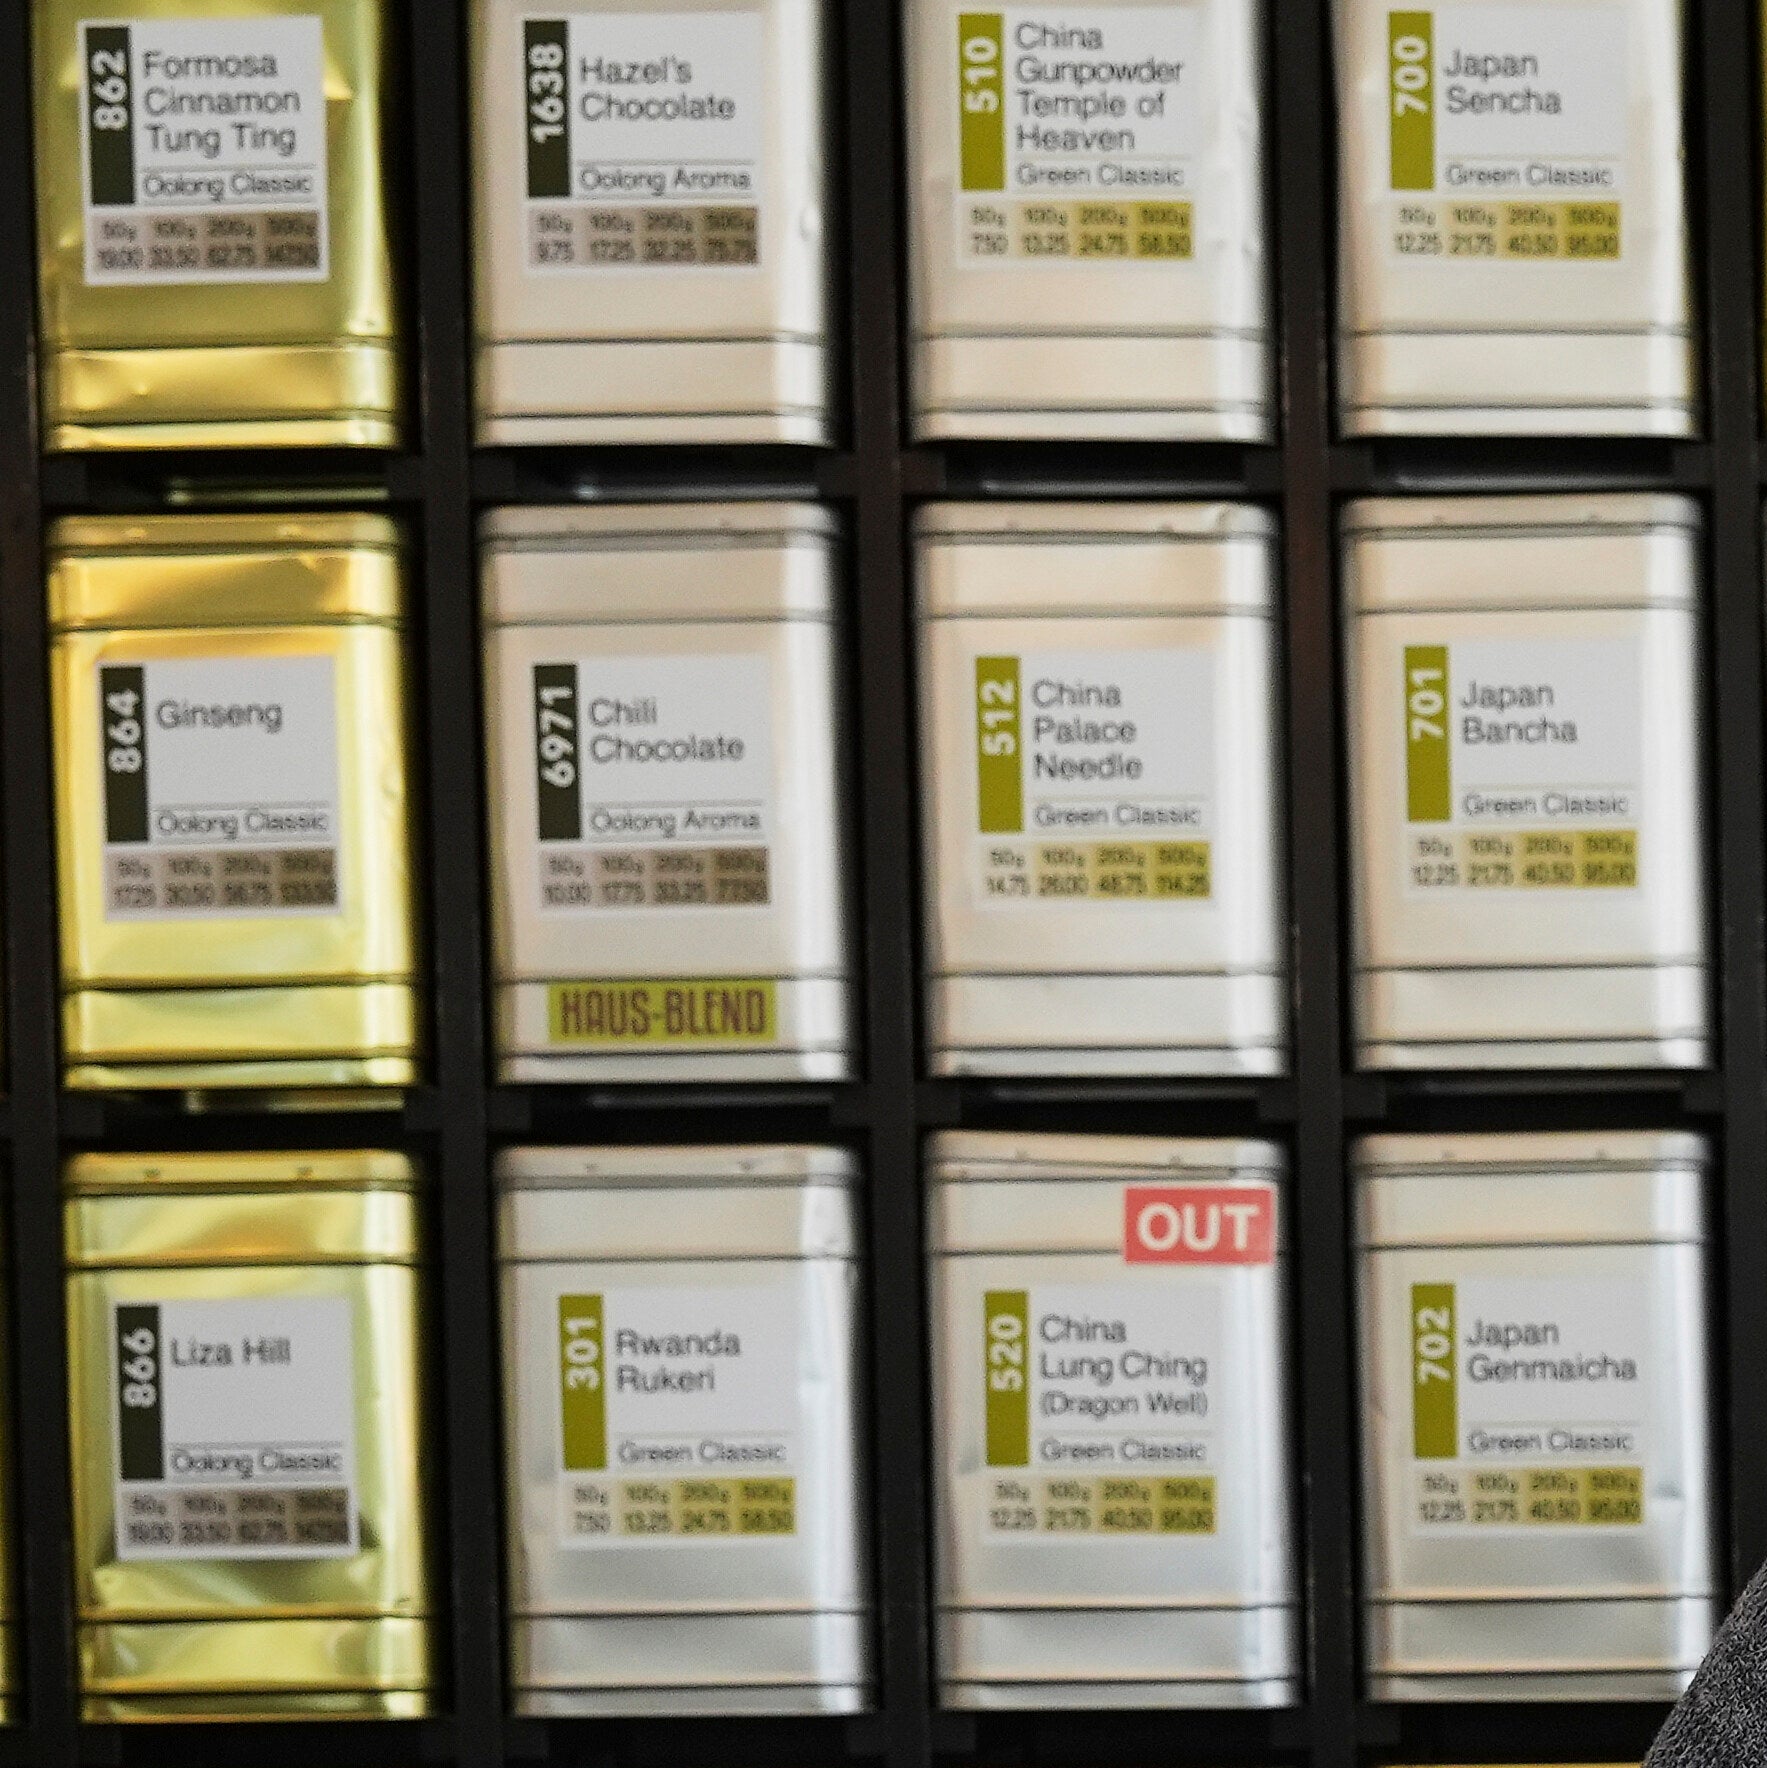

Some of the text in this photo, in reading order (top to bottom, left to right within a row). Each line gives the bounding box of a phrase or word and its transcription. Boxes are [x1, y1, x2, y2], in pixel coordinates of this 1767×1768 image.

[1014, 21, 1104, 51] China
[142, 50, 278, 80] Formosa
[579, 55, 692, 85] Hazel's
[1015, 56, 1183, 88] Gunpowder
[1394, 35, 1428, 117] 700
[1443, 49, 1538, 82] Japan
[143, 86, 301, 117] Cinnamon
[531, 43, 564, 143] 1638
[579, 92, 735, 121] Chocolate
[1016, 88, 1165, 122] Temple of
[1446, 84, 1562, 115] Sencha
[144, 122, 296, 159] Tung Ting
[1016, 124, 1135, 152] Heaven
[143, 168, 311, 205] Oolong Classic
[1031, 678, 1122, 709] China
[1459, 681, 1554, 714] Japan
[155, 700, 282, 734] Ginseng
[588, 697, 657, 728] Chili
[982, 680, 1016, 755] 512
[109, 690, 142, 773] 864
[1032, 715, 1137, 744] Palace
[1462, 716, 1577, 745] Bancha
[588, 734, 744, 764] Chocolate
[1033, 753, 1143, 782] Needle
[560, 988, 766, 1037] HAUS-BLEND
[1137, 1202, 1260, 1252] OUT
[615, 1328, 741, 1357] Rwanda
[1038, 1314, 1127, 1344] China
[1417, 1305, 1451, 1383] 702
[1464, 1320, 1559, 1351] Japan
[170, 1337, 291, 1368] Liza Hill
[566, 1317, 601, 1390] 301
[1466, 1353, 1637, 1383] Genmaicha
[616, 1364, 715, 1394] Rukeri
[1039, 1350, 1207, 1387] Lung Ching
[1039, 1390, 1207, 1422] (Dragon Well)
